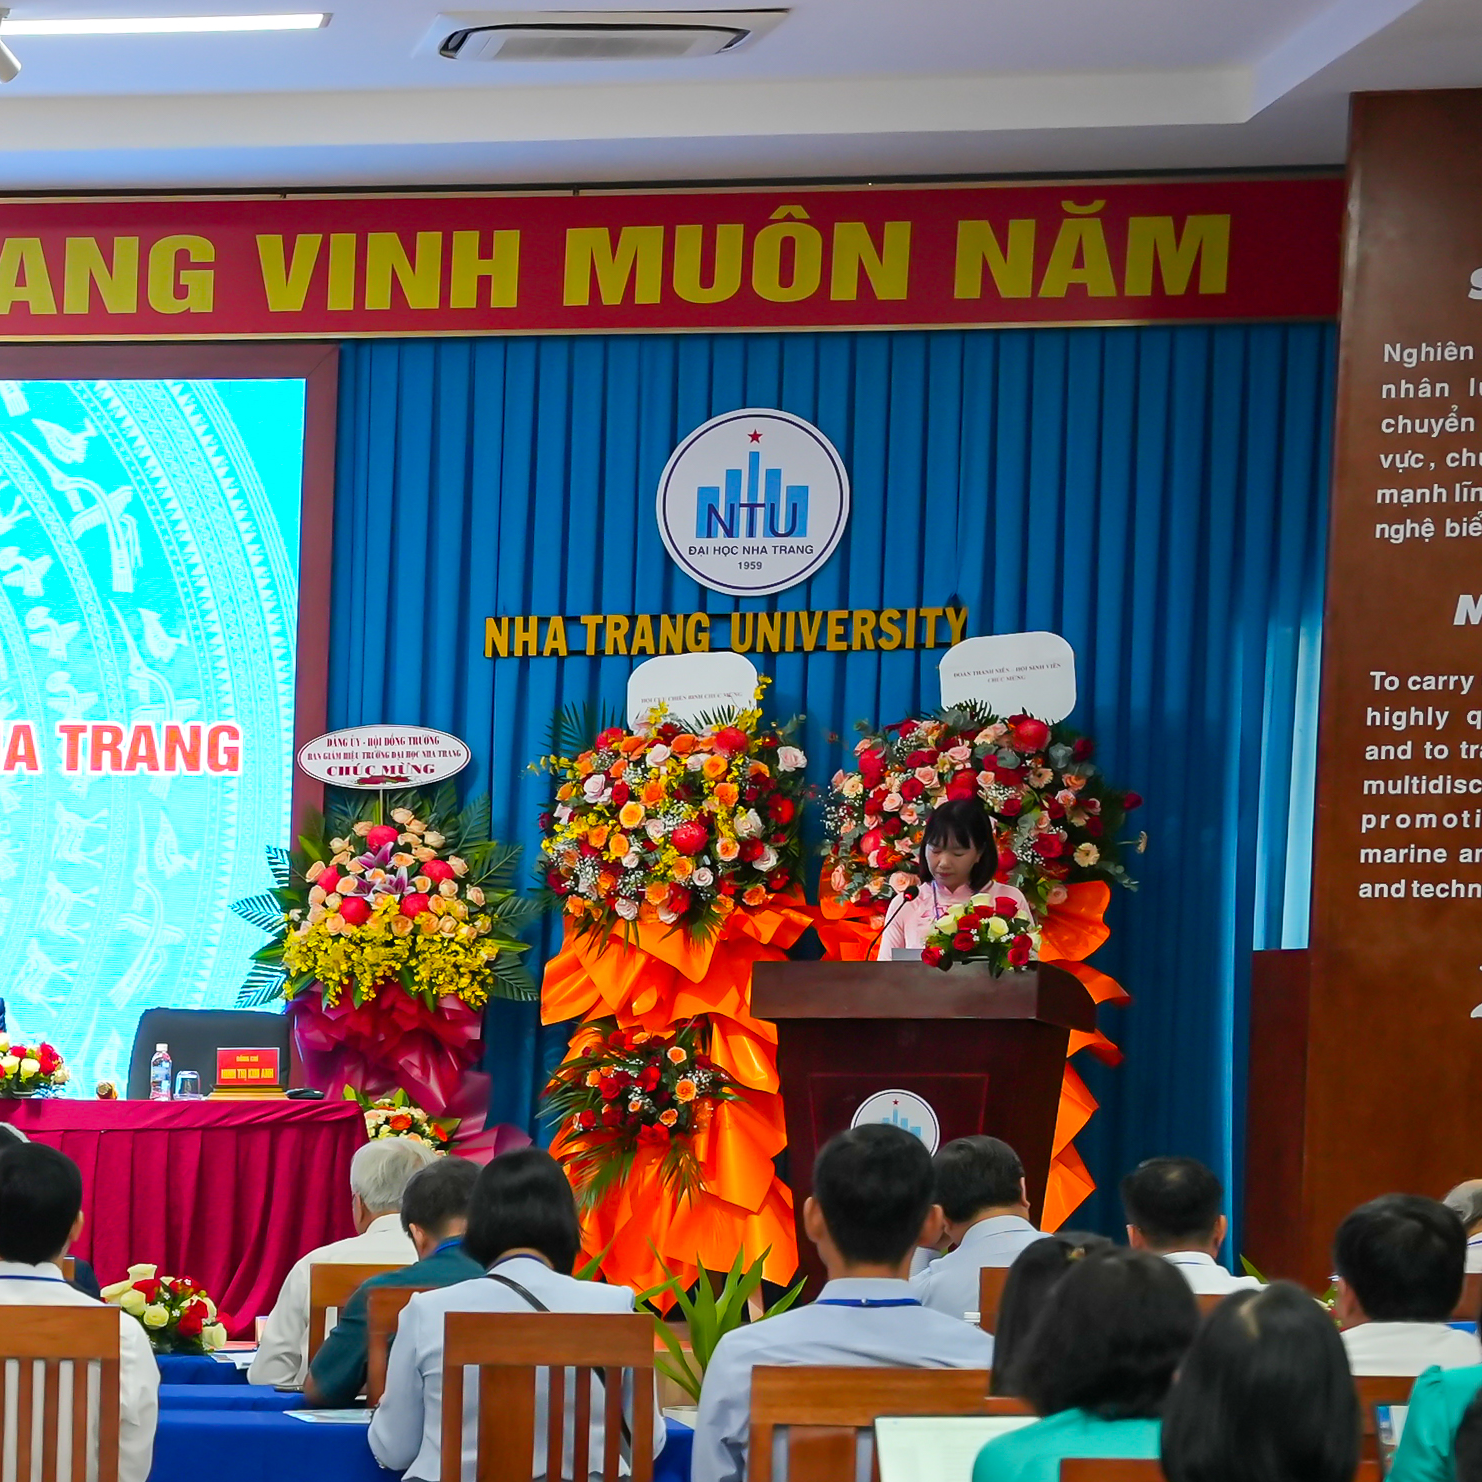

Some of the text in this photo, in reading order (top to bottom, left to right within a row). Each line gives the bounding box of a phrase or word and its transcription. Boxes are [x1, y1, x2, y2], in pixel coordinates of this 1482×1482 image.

[255, 230, 520, 313] VINH
[563, 205, 912, 307] MUÔN
[953, 200, 1231, 299] NĂM
[1383, 340, 1474, 368] Nghiên
[1381, 377, 1449, 399] nhân
[1381, 404, 1475, 438] chuyển
[1376, 483, 1447, 508] mạnh
[706, 502, 797, 538] NTU
[1375, 517, 1435, 544] nghệ
[688, 545, 814, 557] ĐẠI HỌC NHA TRANG
[738, 561, 763, 570] 1959
[485, 606, 968, 657] NHA TRANG UNIVERSITY
[1369, 671, 1475, 695] To carry
[1366, 706, 1450, 731] highly
[59, 725, 241, 774] TRANG
[1365, 740, 1412, 761] and
[327, 762, 435, 777] CHÚC MỪNG
[1359, 843, 1448, 864] marine
[1358, 878, 1406, 898] and
